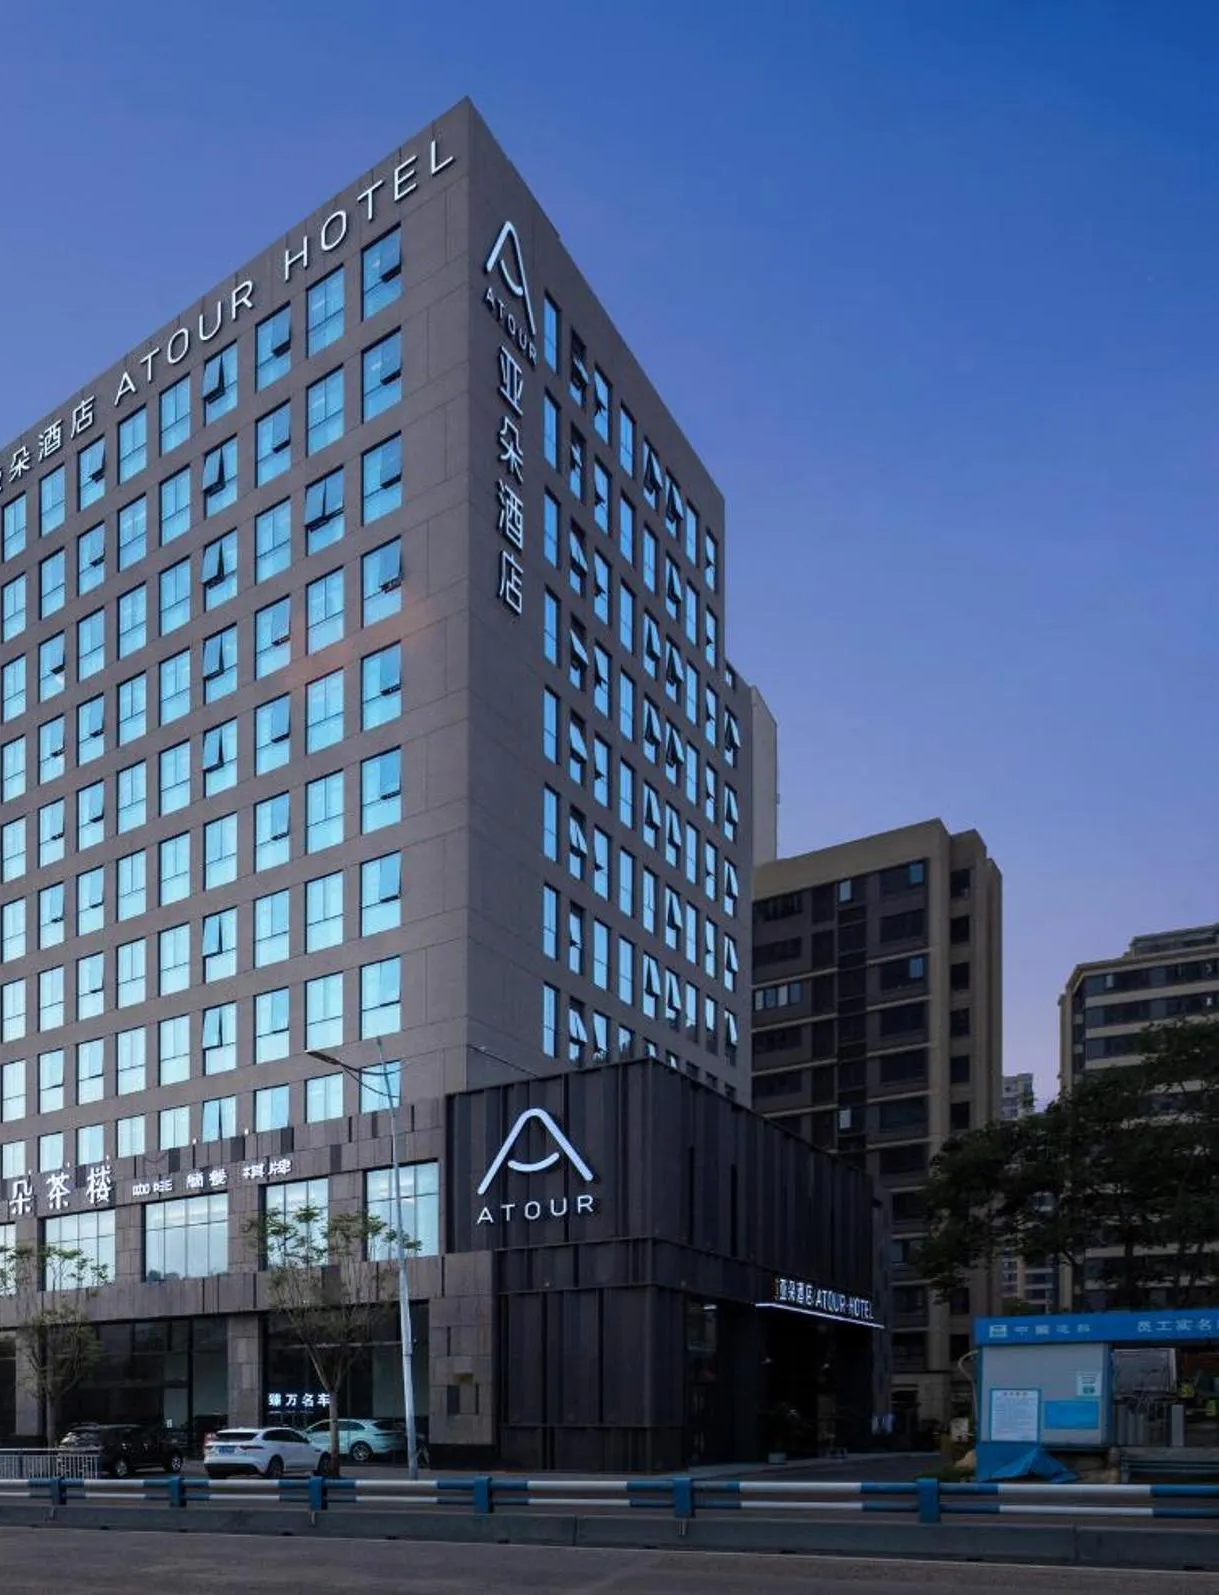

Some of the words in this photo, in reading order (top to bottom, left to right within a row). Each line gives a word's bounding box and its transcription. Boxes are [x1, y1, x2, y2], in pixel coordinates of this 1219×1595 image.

[115, 280, 253, 406] ATOUR
[284, 140, 454, 281] HOTEL
[486, 286, 537, 366] ATOUR
[498, 344, 524, 615] 亚朵酒店
[132, 1179, 173, 1197] 咖啡
[477, 1195, 594, 1225] ATOUR
[1137, 1318, 1219, 1333] 员工实名
